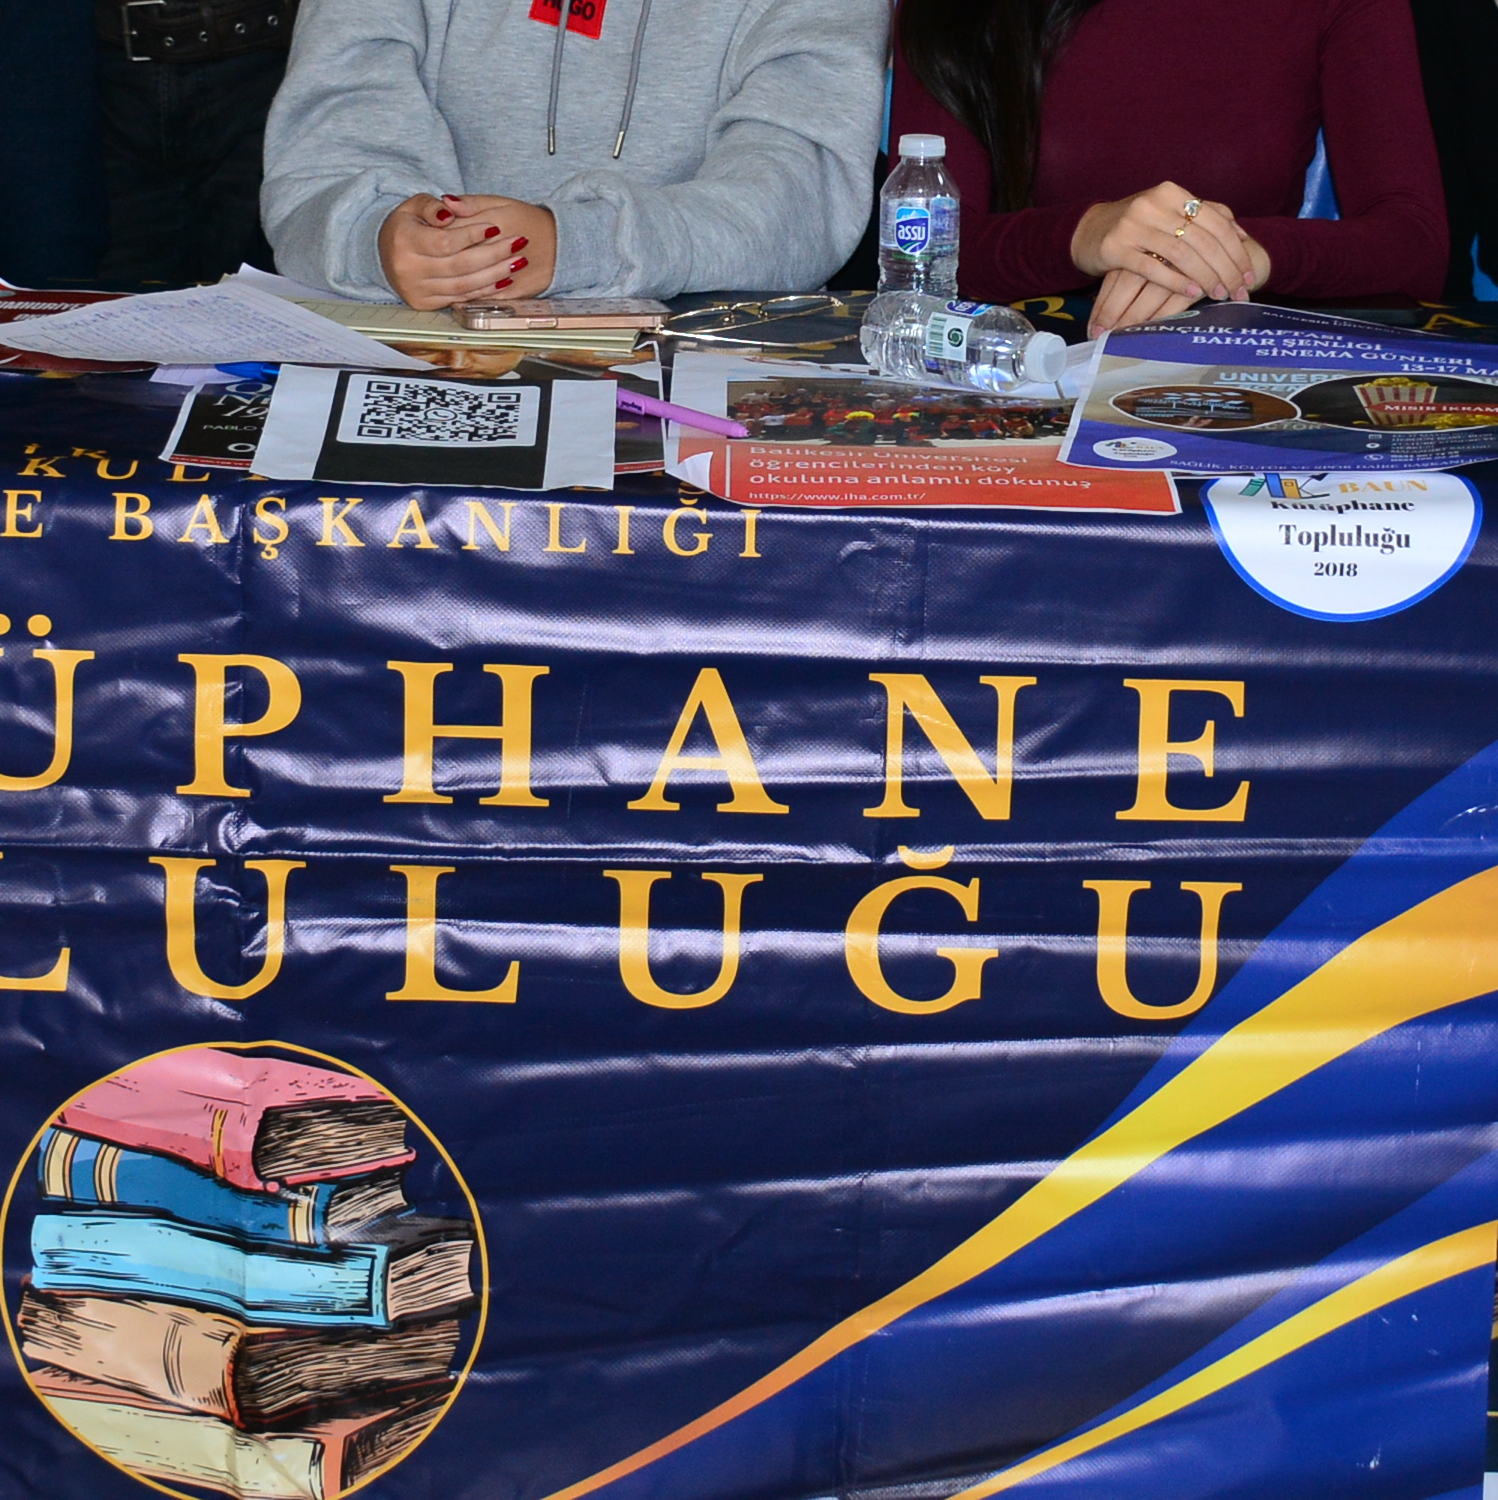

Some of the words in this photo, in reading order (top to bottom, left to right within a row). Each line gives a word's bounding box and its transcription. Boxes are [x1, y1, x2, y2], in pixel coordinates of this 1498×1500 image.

[1124, 325, 1233, 335] GENÇLİK
[1191, 335, 1276, 346] BAHAR
[1255, 347, 1354, 360] SİNEMA
[1360, 350, 1474, 366] GÜNLERİ
[203, 424, 258, 432] PABLO
[749, 457, 967, 472] öğrencilerinden
[972, 462, 1016, 476] köy
[749, 473, 860, 485] okuluna
[867, 473, 970, 486] anlamlı
[977, 475, 1092, 490] dokunuş
[1338, 479, 1429, 494] BAUN
[107, 491, 763, 561] BAŞKANLIĞI
[1278, 523, 1412, 555] Topluluğu
[1312, 561, 1359, 578] 2018
